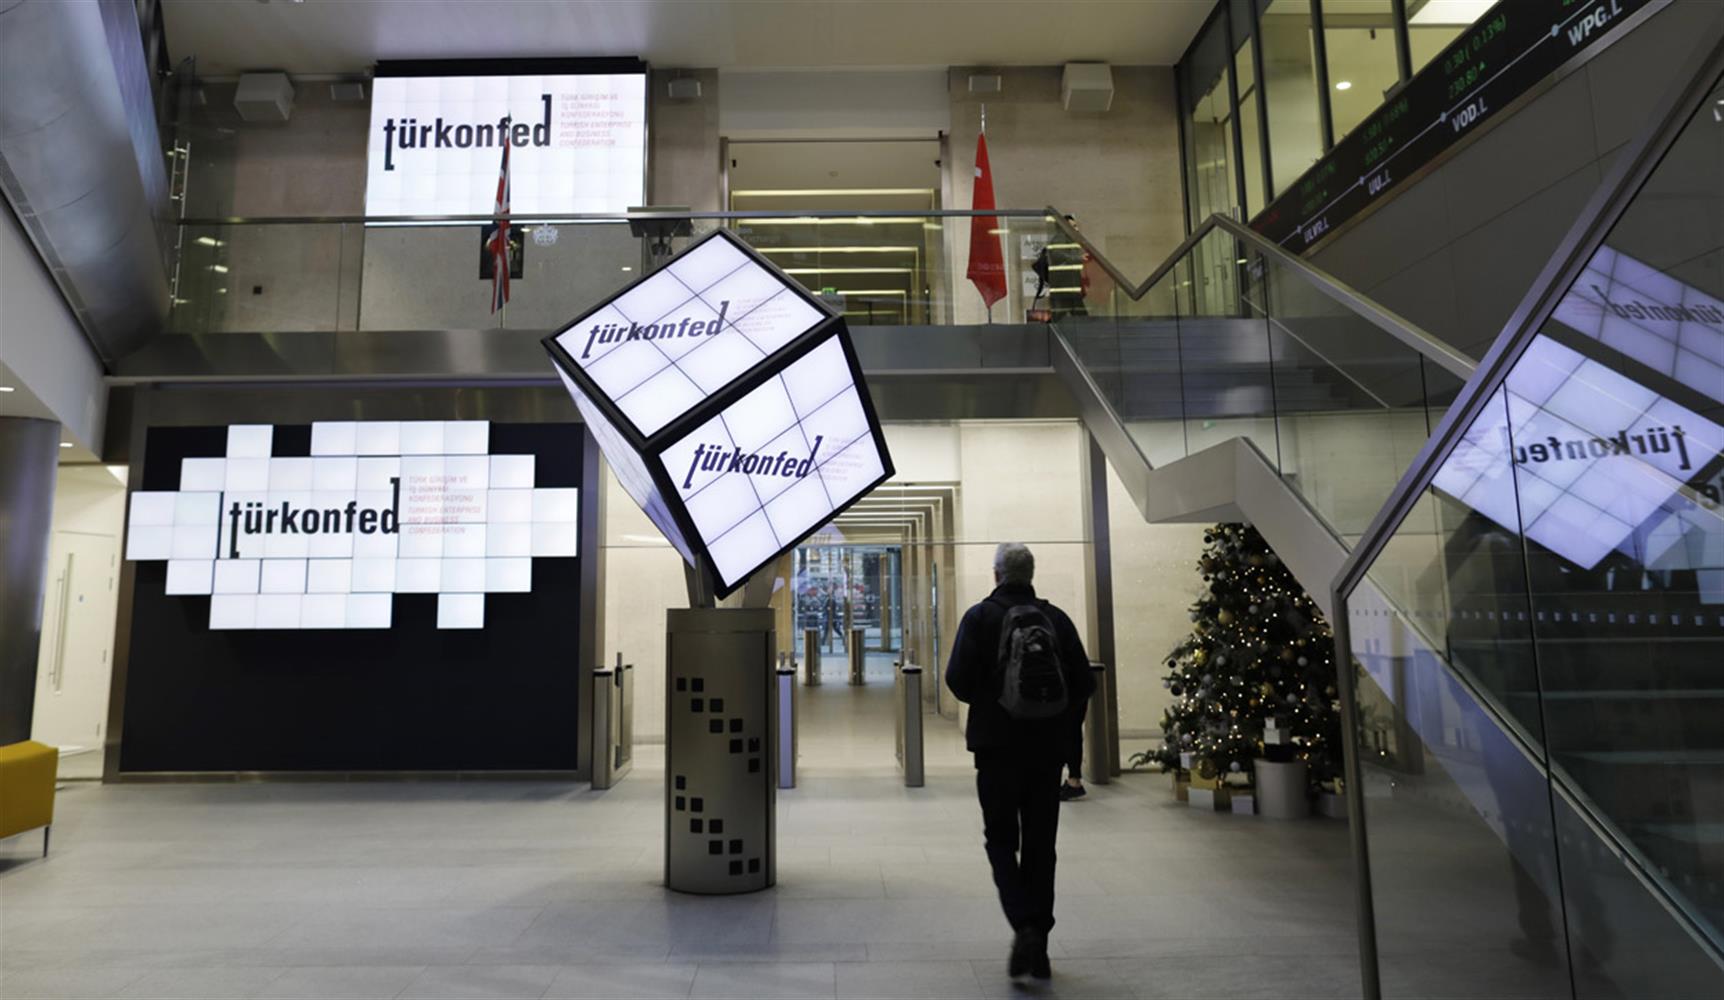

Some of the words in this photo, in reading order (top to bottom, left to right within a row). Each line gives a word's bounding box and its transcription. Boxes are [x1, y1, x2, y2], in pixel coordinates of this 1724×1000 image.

[384, 94, 552, 170] türkonfed
[1452, 97, 1488, 132] VOD.L
[582, 300, 730, 359] türkonfed
[683, 435, 823, 489] türkonfed
[229, 477, 400, 558] türkonfed
